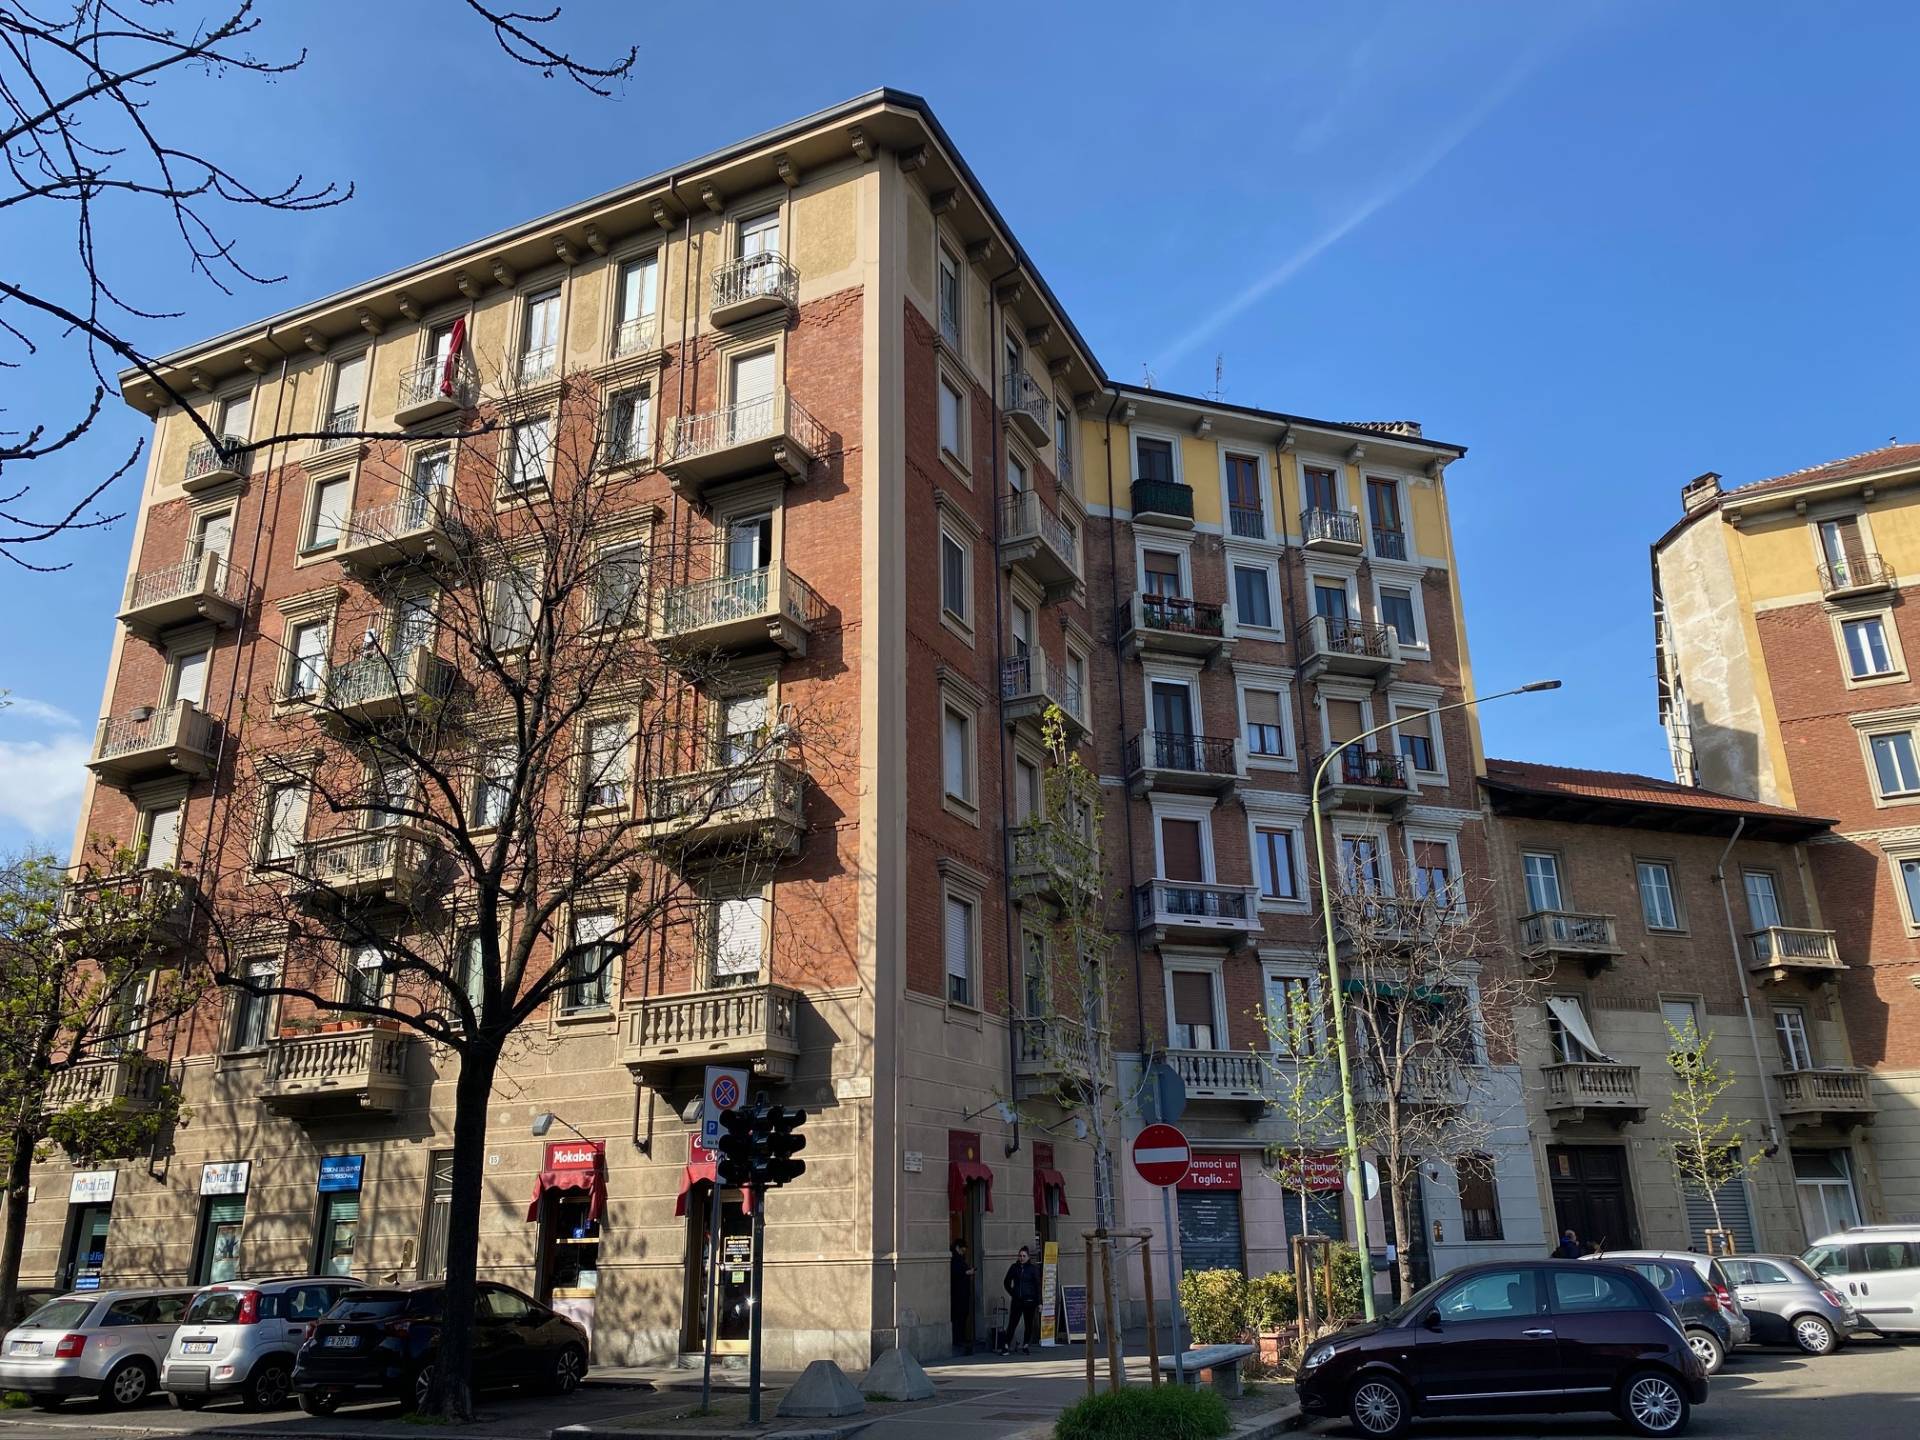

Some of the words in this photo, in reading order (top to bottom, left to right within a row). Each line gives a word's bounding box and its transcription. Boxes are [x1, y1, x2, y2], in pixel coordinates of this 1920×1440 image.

[708, 1122, 716, 1134] P
[1190, 1158, 1222, 1169] iamoci
[1224, 1161, 1237, 1169] un
[205, 1170, 228, 1183] Royal
[229, 1170, 243, 1182] Fin
[1312, 1176, 1341, 1184] DONNA
[75, 1178, 96, 1192] Royal
[96, 1178, 110, 1191] Fin
